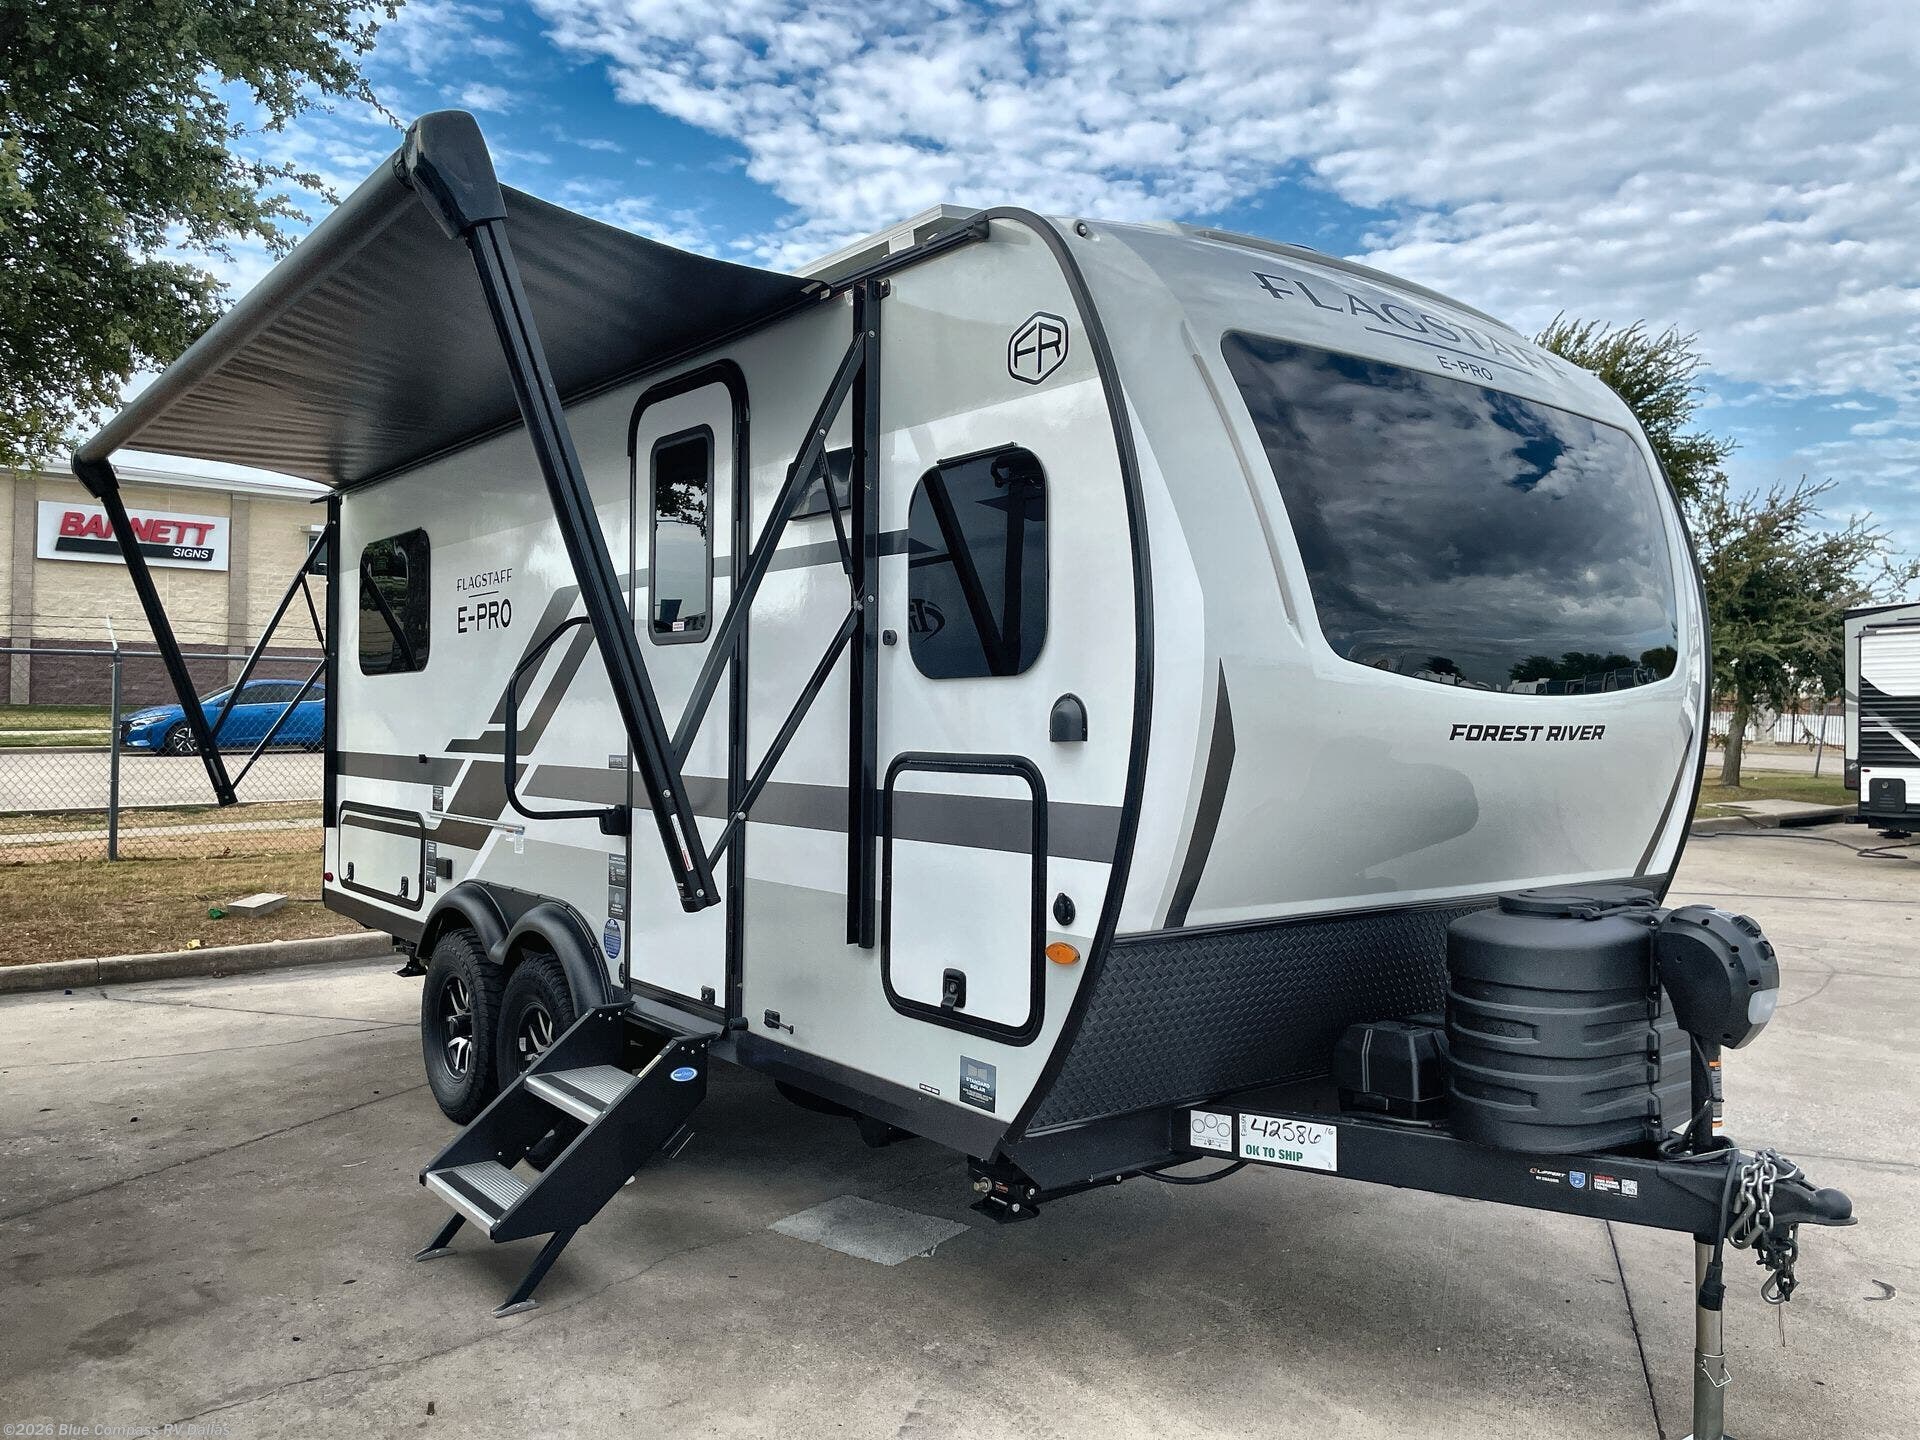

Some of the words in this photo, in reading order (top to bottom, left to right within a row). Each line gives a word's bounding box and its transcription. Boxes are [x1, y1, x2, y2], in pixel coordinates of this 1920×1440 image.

[1252, 270, 1568, 379] FLAGSTAFF
[1436, 354, 1494, 381] E-PRO
[172, 547, 209, 559] SIGNS
[456, 568, 513, 592] FLAGSTAFF
[457, 598, 512, 634] E-PRO
[1449, 723, 1544, 742] FOREST
[1545, 724, 1606, 741] RIVER
[1250, 1118, 1321, 1144] 42586
[1245, 1144, 1260, 1155] OK
[1262, 1146, 1276, 1158] TO
[1278, 1150, 1303, 1161] SHIP
